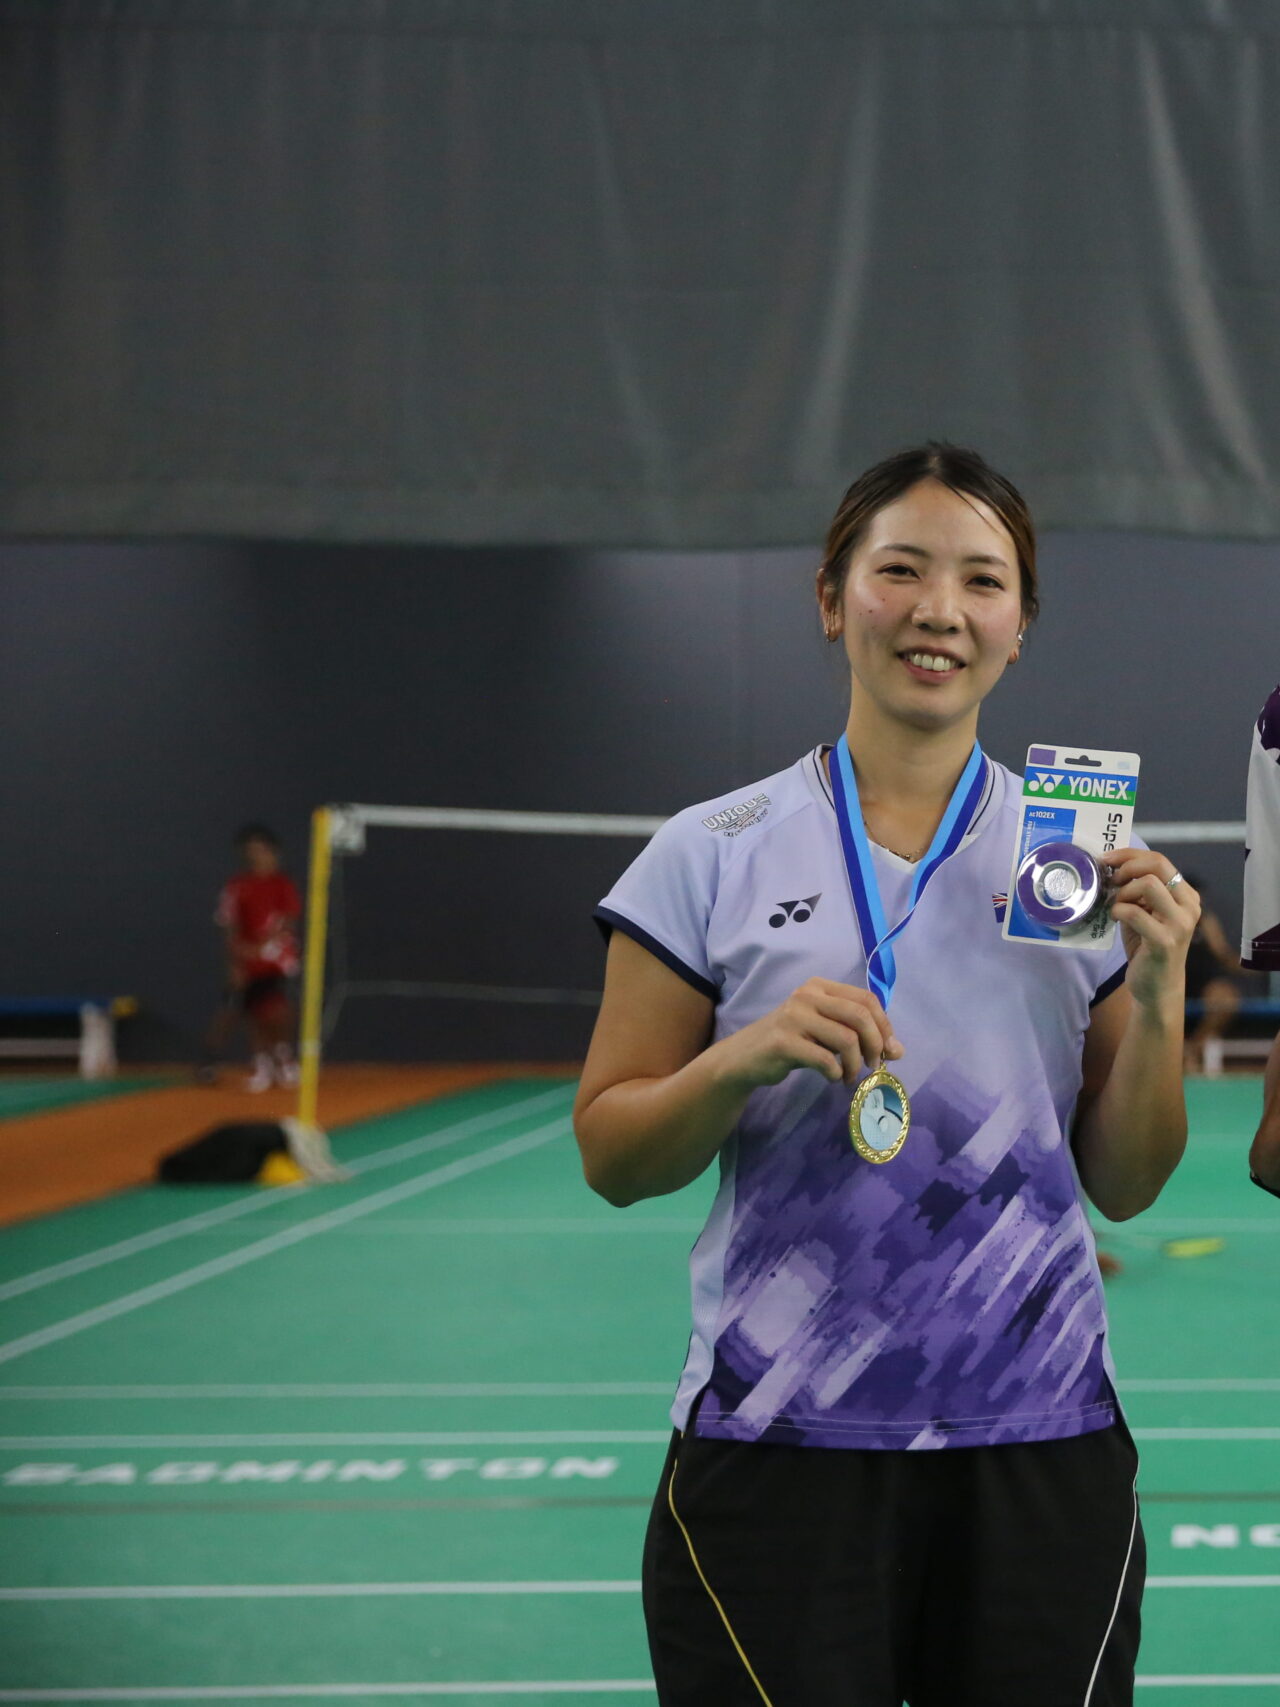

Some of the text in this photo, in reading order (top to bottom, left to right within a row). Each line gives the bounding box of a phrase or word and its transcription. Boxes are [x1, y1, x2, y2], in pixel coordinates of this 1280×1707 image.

[1068, 775, 1130, 800] YONEX
[1102, 812, 1123, 851] Supe
[3, 1456, 618, 1486] BADMINTON
